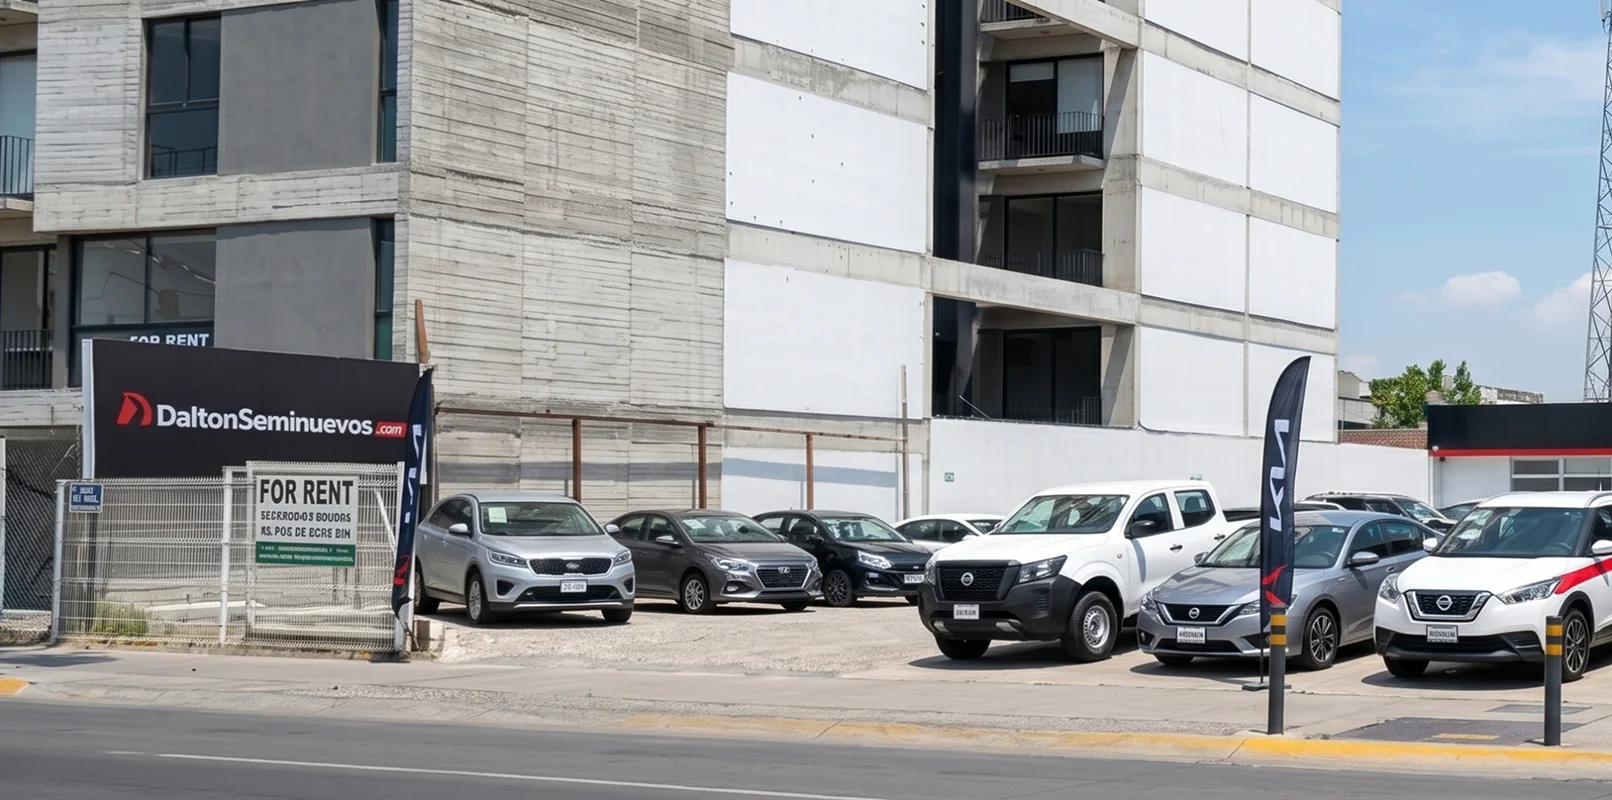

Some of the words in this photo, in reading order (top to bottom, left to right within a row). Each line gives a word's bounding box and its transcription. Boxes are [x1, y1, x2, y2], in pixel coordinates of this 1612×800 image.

[165, 333, 210, 347] RENT
[156, 404, 373, 435] DaltonSeminuevos
[376, 425, 402, 435] .com
[260, 479, 297, 504] FOR
[303, 480, 354, 505] RENT
[294, 527, 307, 538] DE
